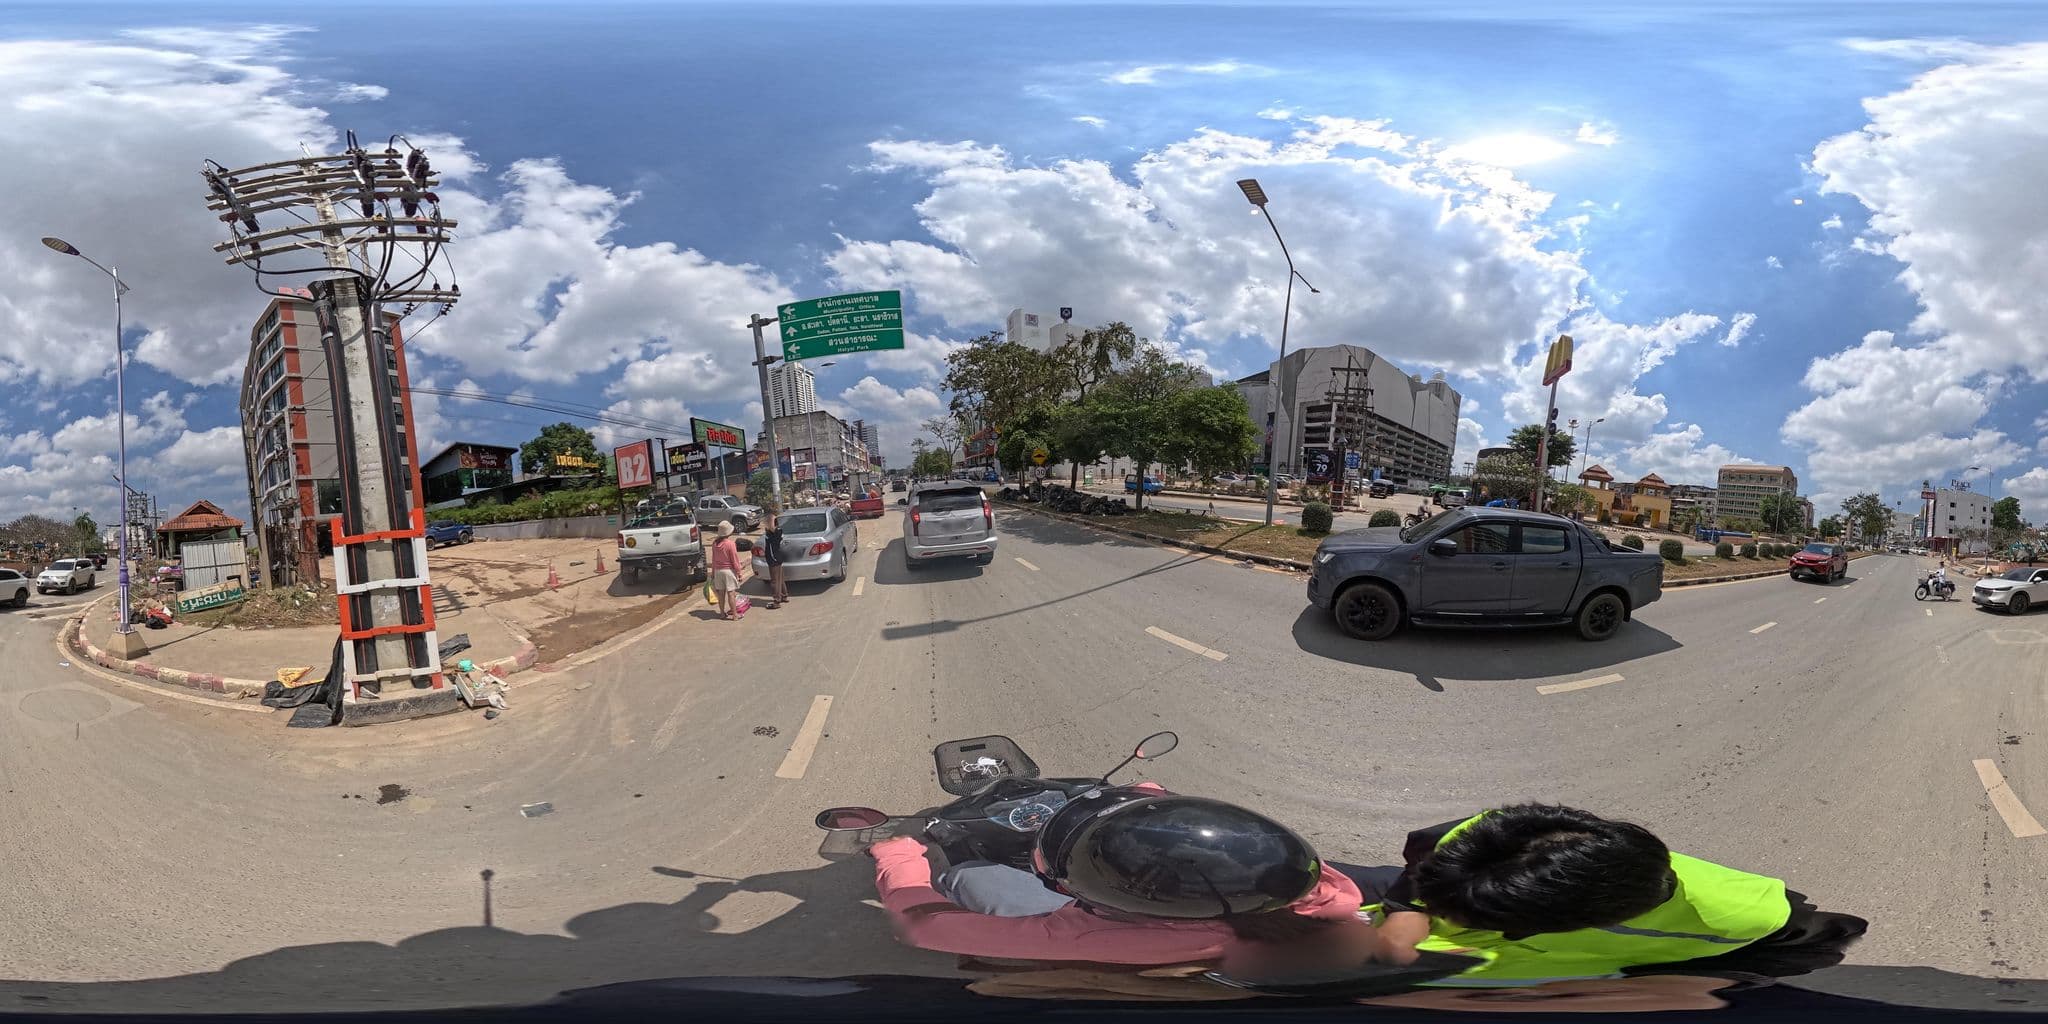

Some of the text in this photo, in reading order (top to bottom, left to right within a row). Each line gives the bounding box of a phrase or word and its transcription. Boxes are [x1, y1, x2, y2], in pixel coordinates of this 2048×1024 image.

[816, 296, 879, 308] สำนักงานเทศบาล
[828, 334, 878, 346] สวนสาธารณะ
[620, 453, 647, 483] B2
[1316, 463, 1328, 472] 79
